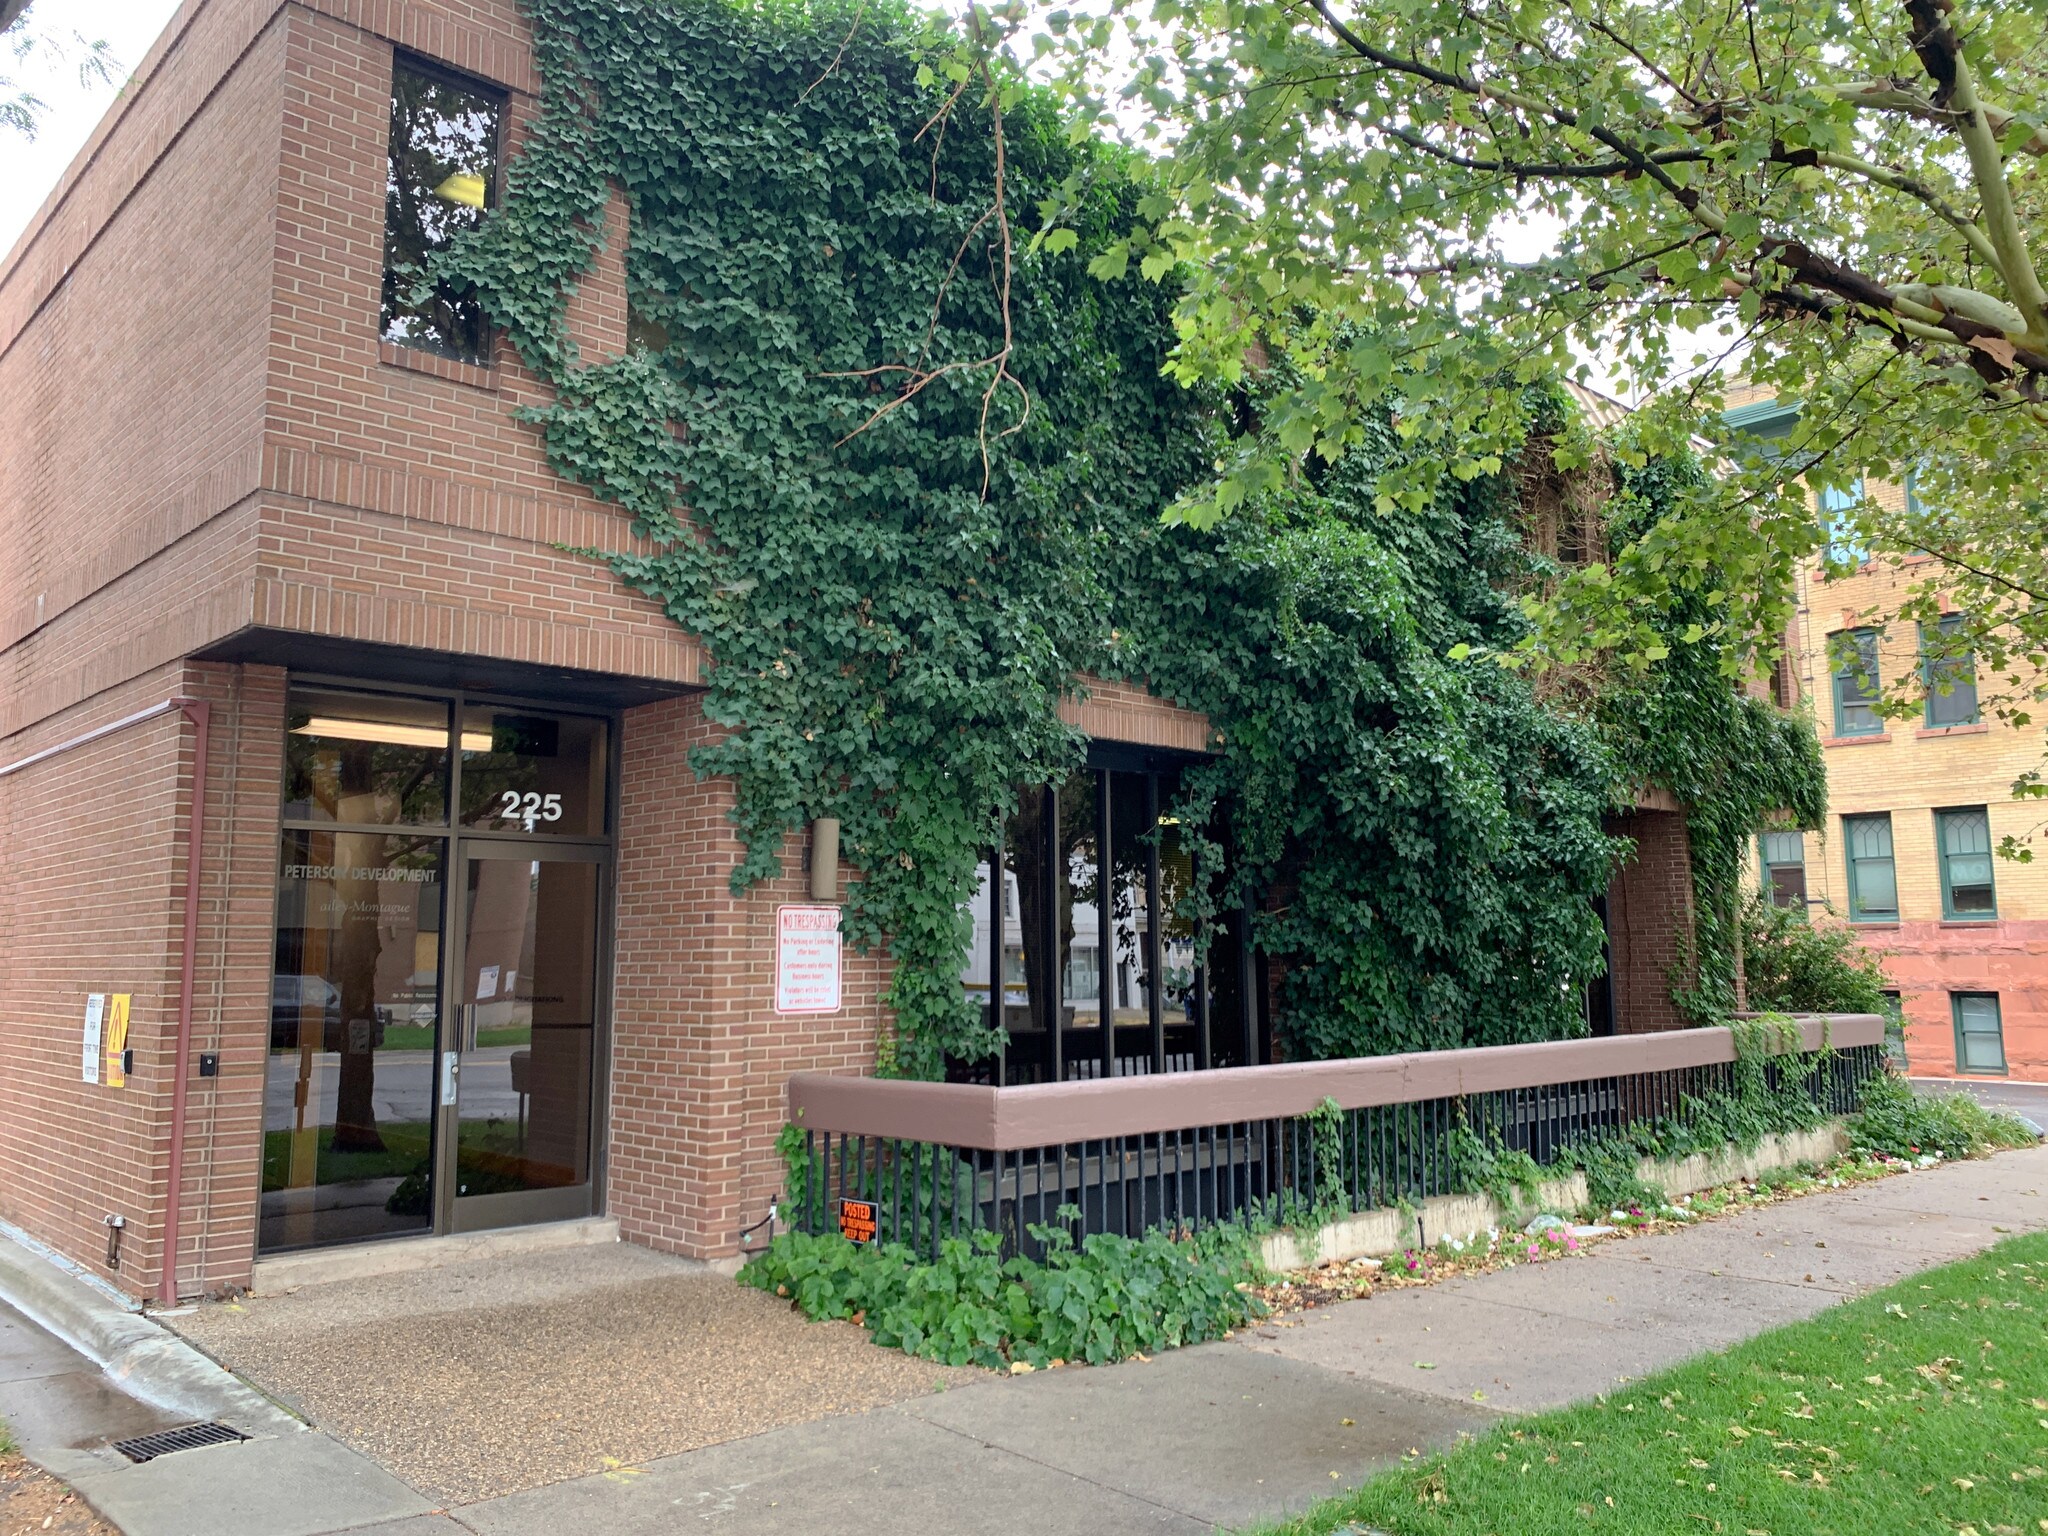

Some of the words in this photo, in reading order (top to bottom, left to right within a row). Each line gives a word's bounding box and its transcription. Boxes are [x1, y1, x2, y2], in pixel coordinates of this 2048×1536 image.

[501, 790, 562, 821] 225
[351, 867, 437, 882] DEVELOPMENT
[783, 914, 793, 928] NO
[794, 914, 837, 929] TRESPASSING
[844, 1201, 871, 1220] POSTED
[840, 1215, 847, 1227] NO
[847, 1217, 876, 1232] TRESPASSING
[844, 1228, 858, 1239] KEEP
[858, 1230, 871, 1242] OUT
